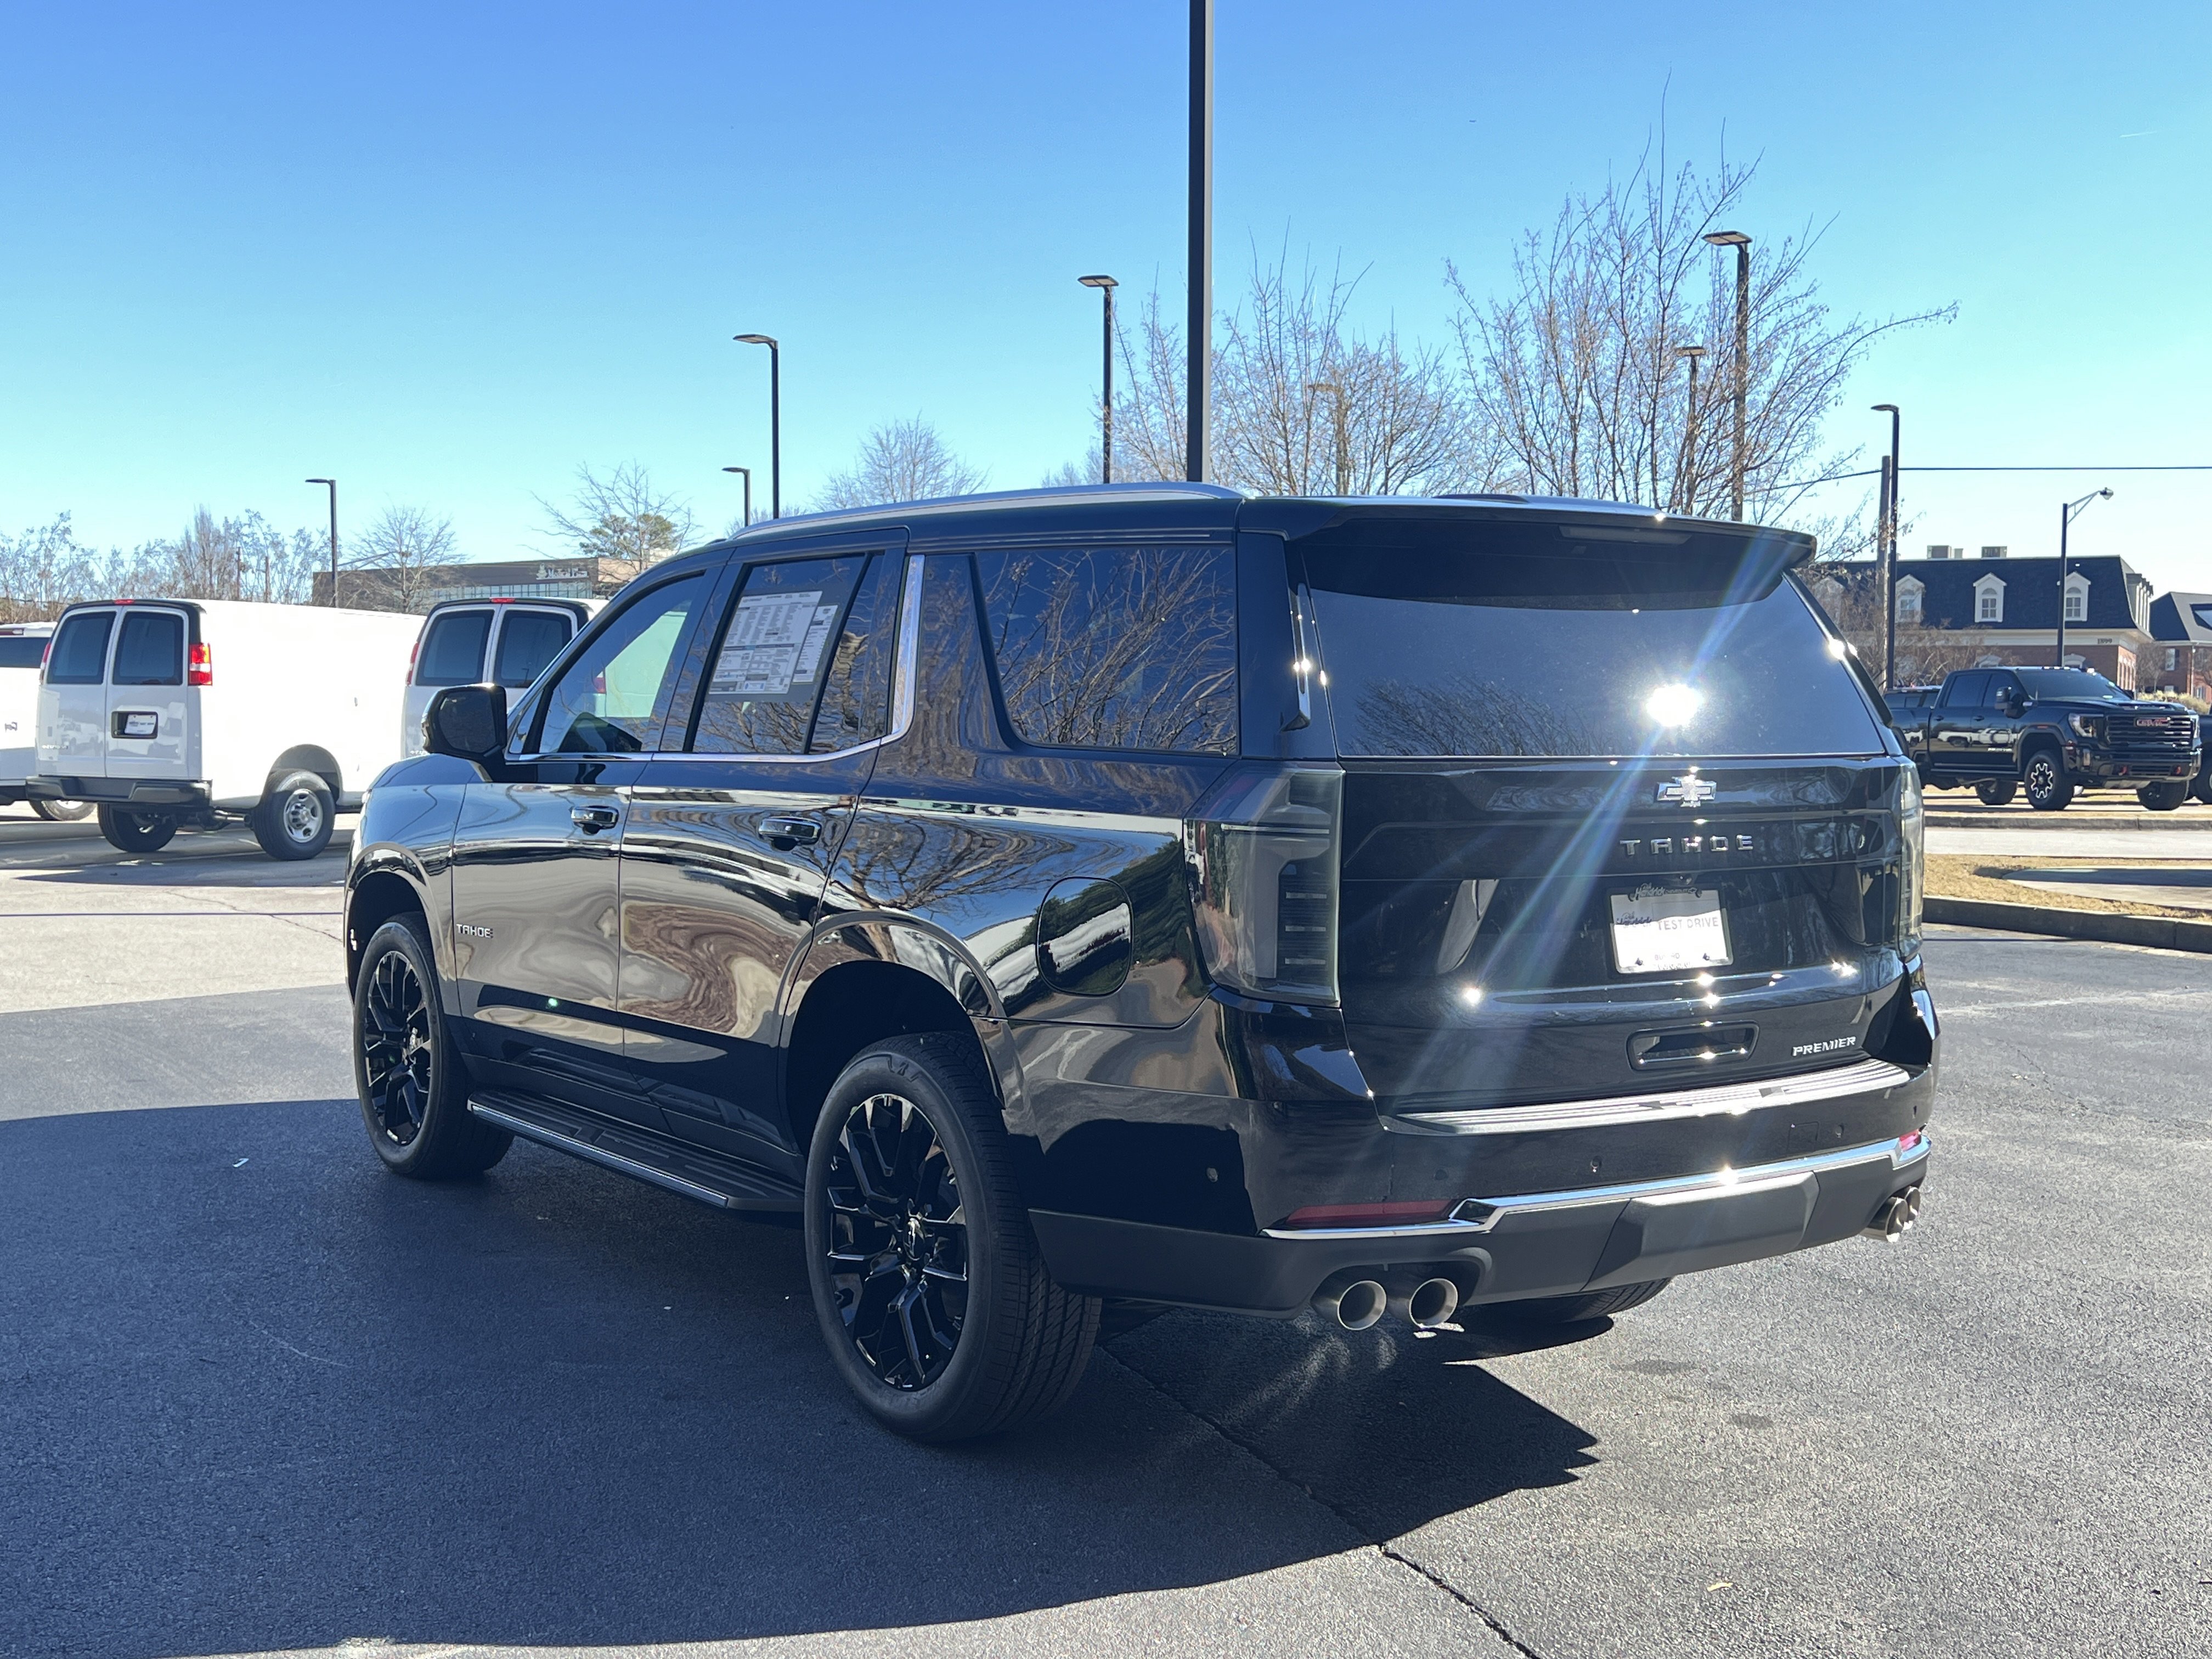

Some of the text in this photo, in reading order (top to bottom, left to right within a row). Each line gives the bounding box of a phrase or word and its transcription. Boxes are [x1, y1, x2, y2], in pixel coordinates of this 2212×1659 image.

[1620, 834, 1753, 856] TAHOE
[456, 923, 493, 939] TAHOE
[1657, 917, 1719, 930] TEST DRIVE
[1792, 1036, 1856, 1056] PREMIER
